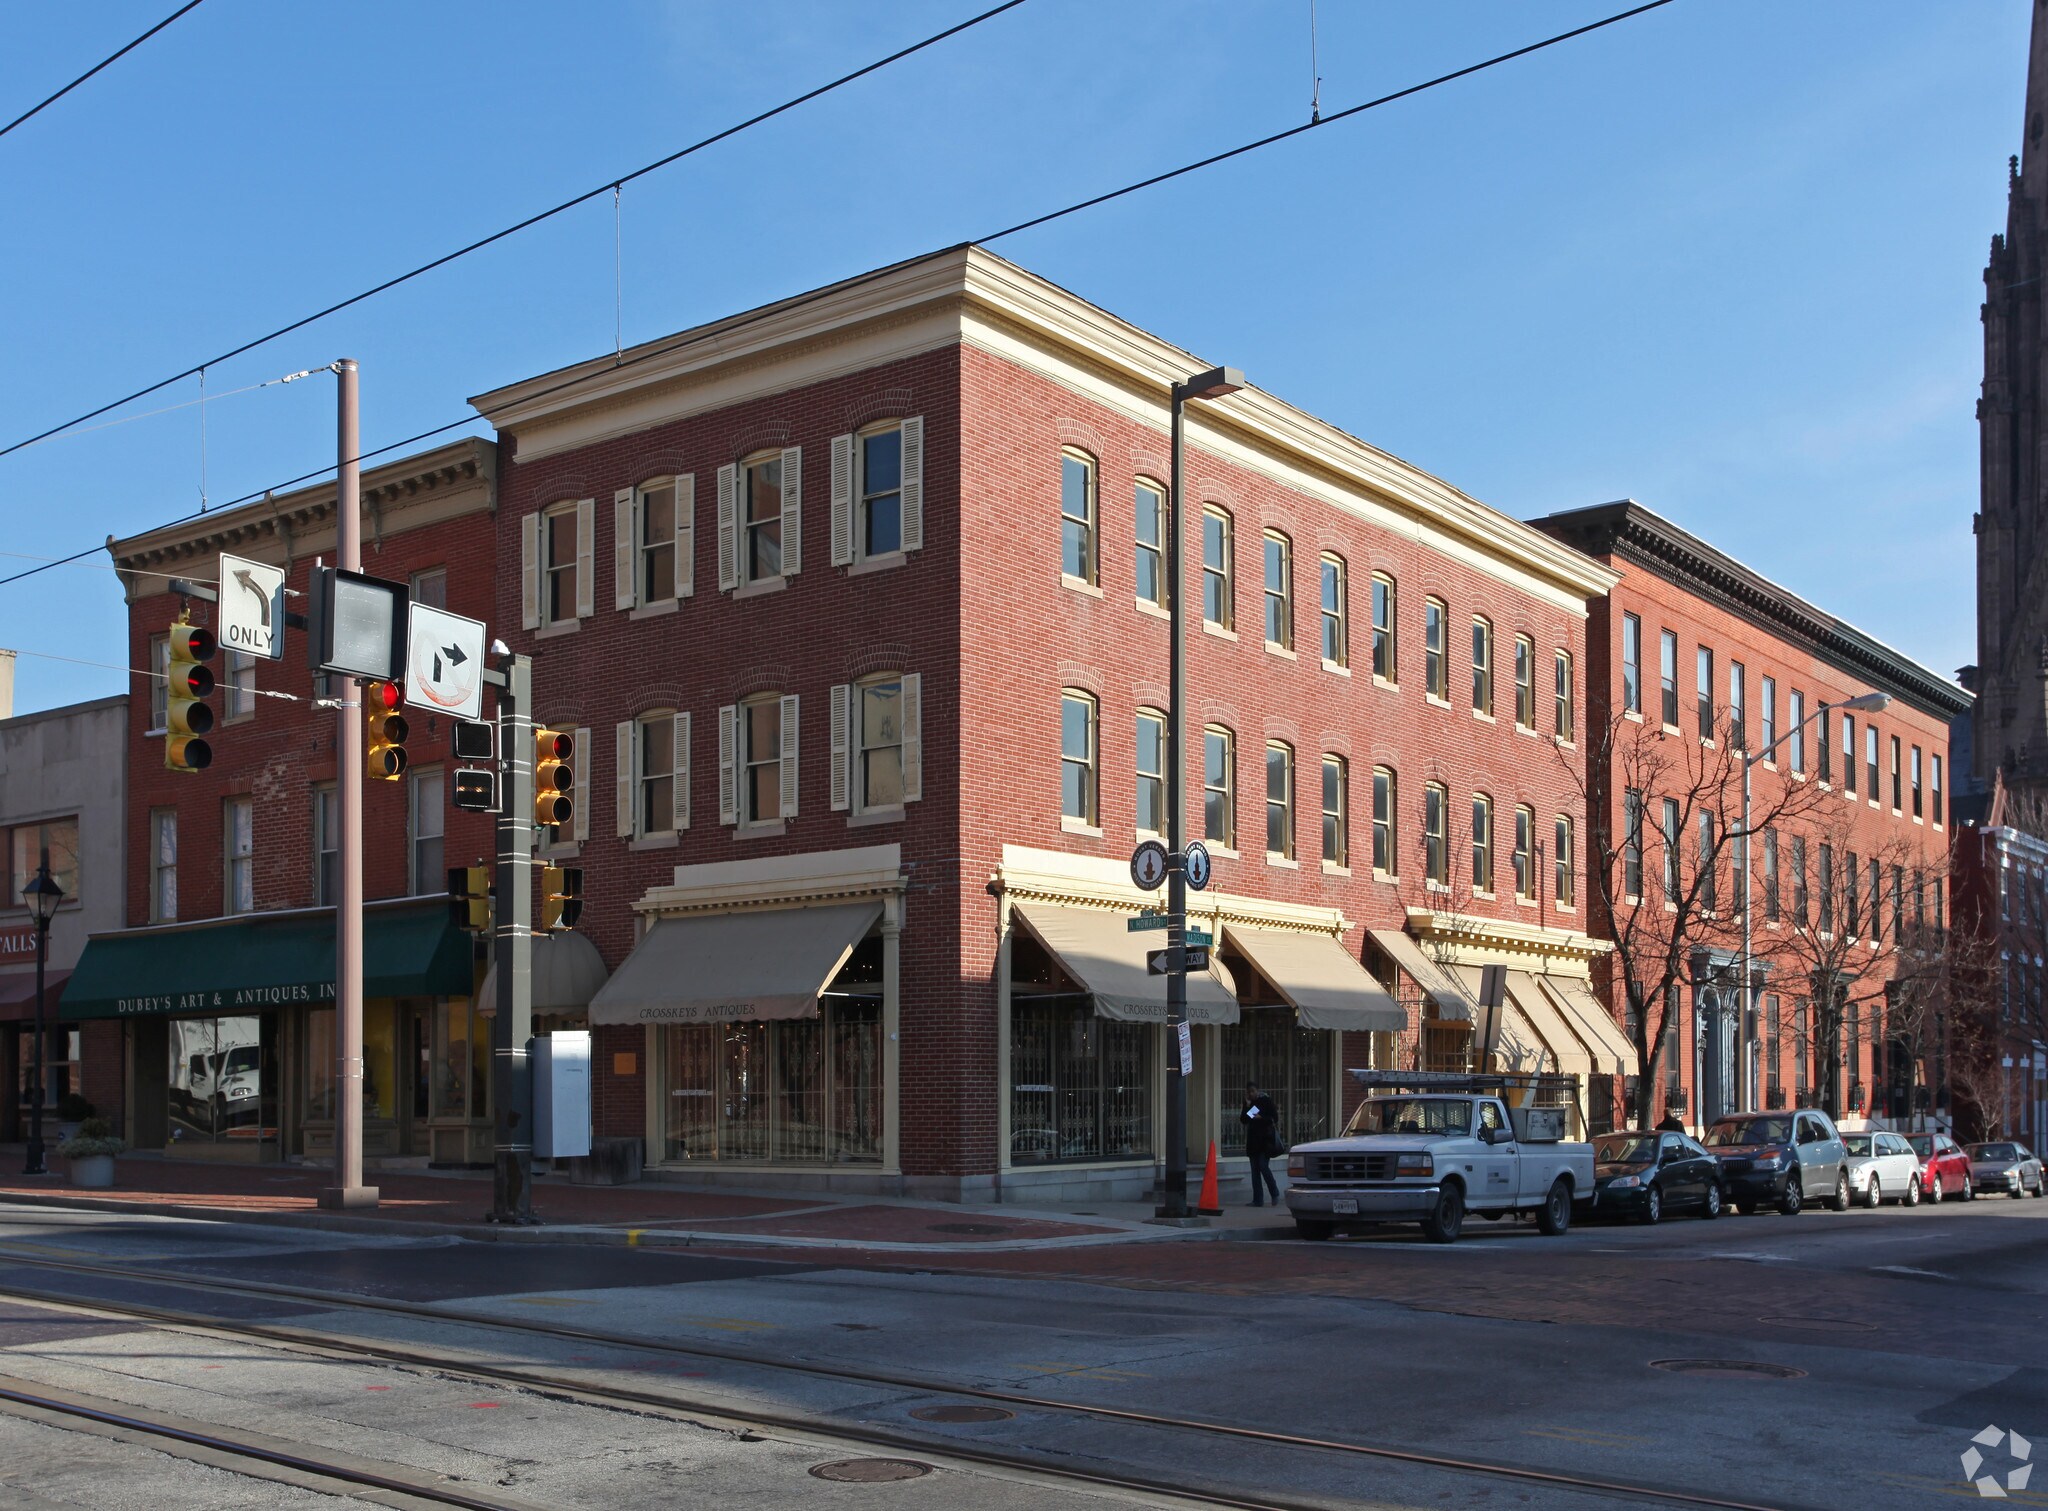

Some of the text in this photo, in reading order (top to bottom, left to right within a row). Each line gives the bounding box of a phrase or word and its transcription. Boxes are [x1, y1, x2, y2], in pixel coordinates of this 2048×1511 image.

[229, 624, 275, 650] ONLY
[1134, 843, 1166, 861] MOUNT VERNON
[1129, 920, 1134, 930] N
[1137, 917, 1161, 930] HOWARD
[1186, 953, 1202, 965] WAY
[118, 983, 336, 1013] DUBEY'S ART & ANTIQUES, IN
[639, 1003, 756, 1019] CROSSKEYS ANTIQUES
[1123, 1003, 1210, 1019] CROSSKEYS IQUES
